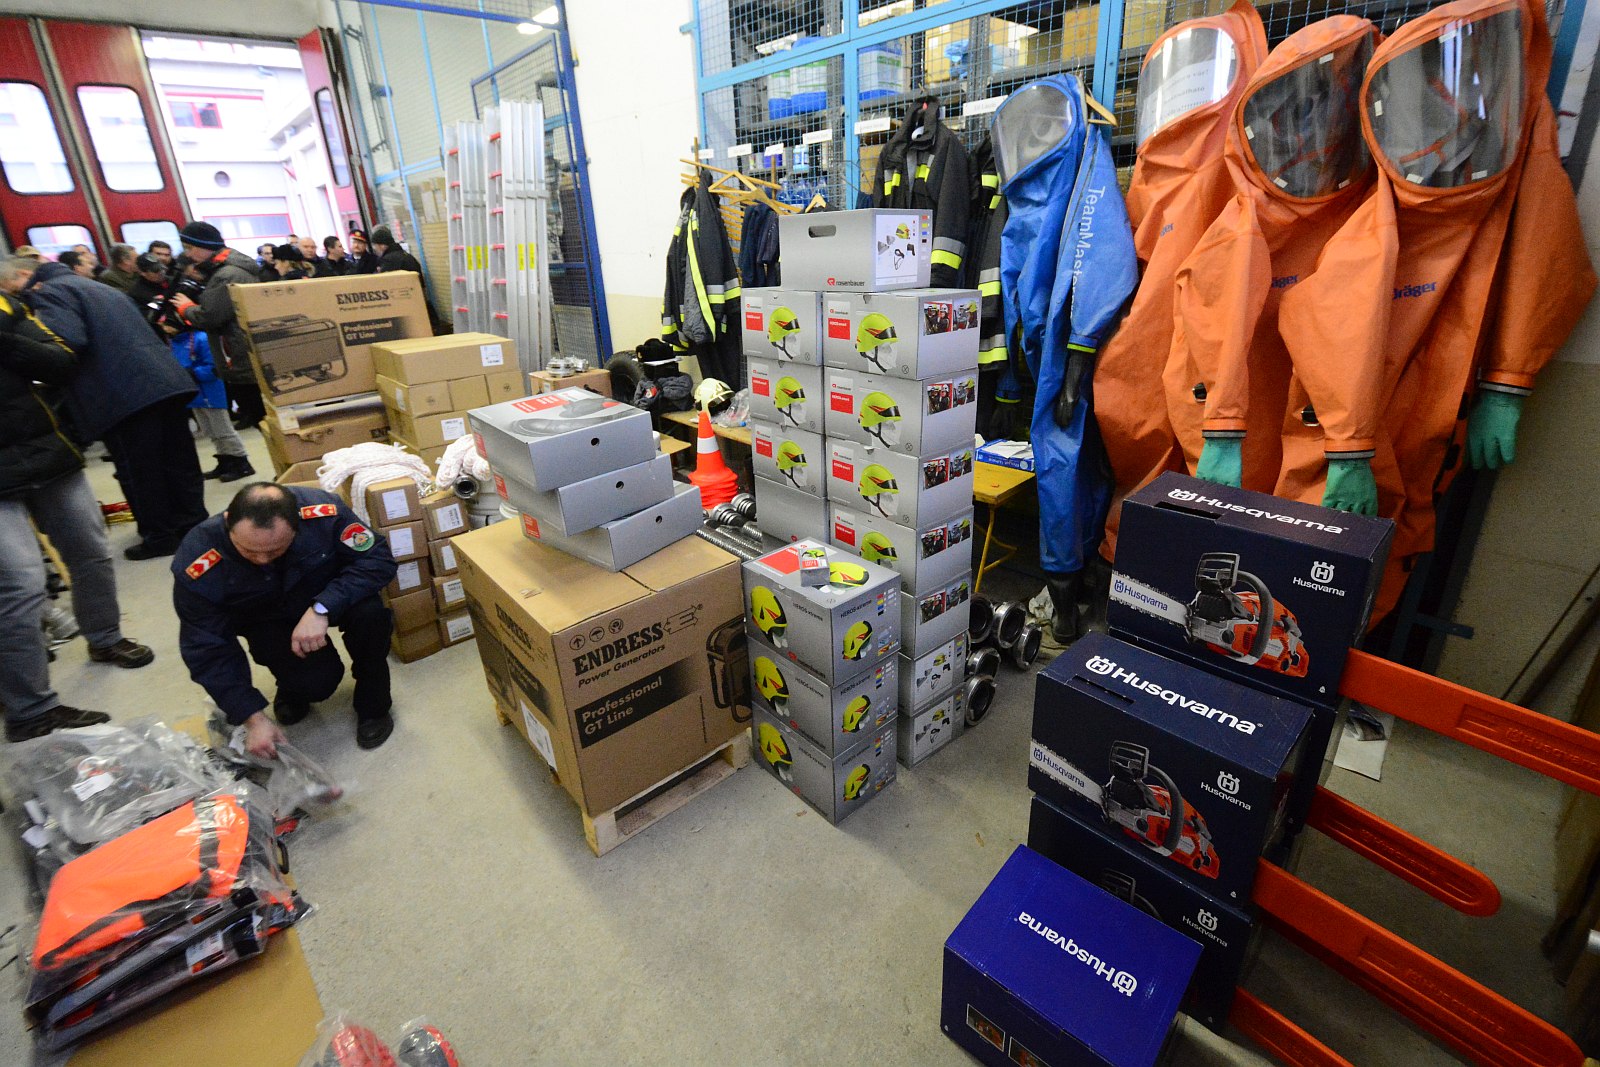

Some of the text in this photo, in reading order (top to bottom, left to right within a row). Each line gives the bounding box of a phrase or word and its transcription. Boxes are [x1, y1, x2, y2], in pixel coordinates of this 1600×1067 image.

[335, 289, 389, 304] ENDRESS
[835, 279, 865, 287] rosenbauer
[343, 321, 393, 333] Professional
[1195, 495, 1343, 535] Husqvarna
[1123, 584, 1169, 612] Husqvarna
[1292, 576, 1346, 597] Husqvarna
[572, 621, 664, 677] ENDRESS
[578, 643, 666, 688] Power Generators
[582, 675, 663, 723] Professional
[1111, 666, 1256, 735] Husqvarna
[584, 705, 634, 735] GT Line
[1042, 754, 1085, 788] Husqvarna
[1200, 781, 1252, 811] Husqvarna
[1018, 911, 1116, 982] Husqvarna
[1182, 915, 1229, 948] Husqvarna
